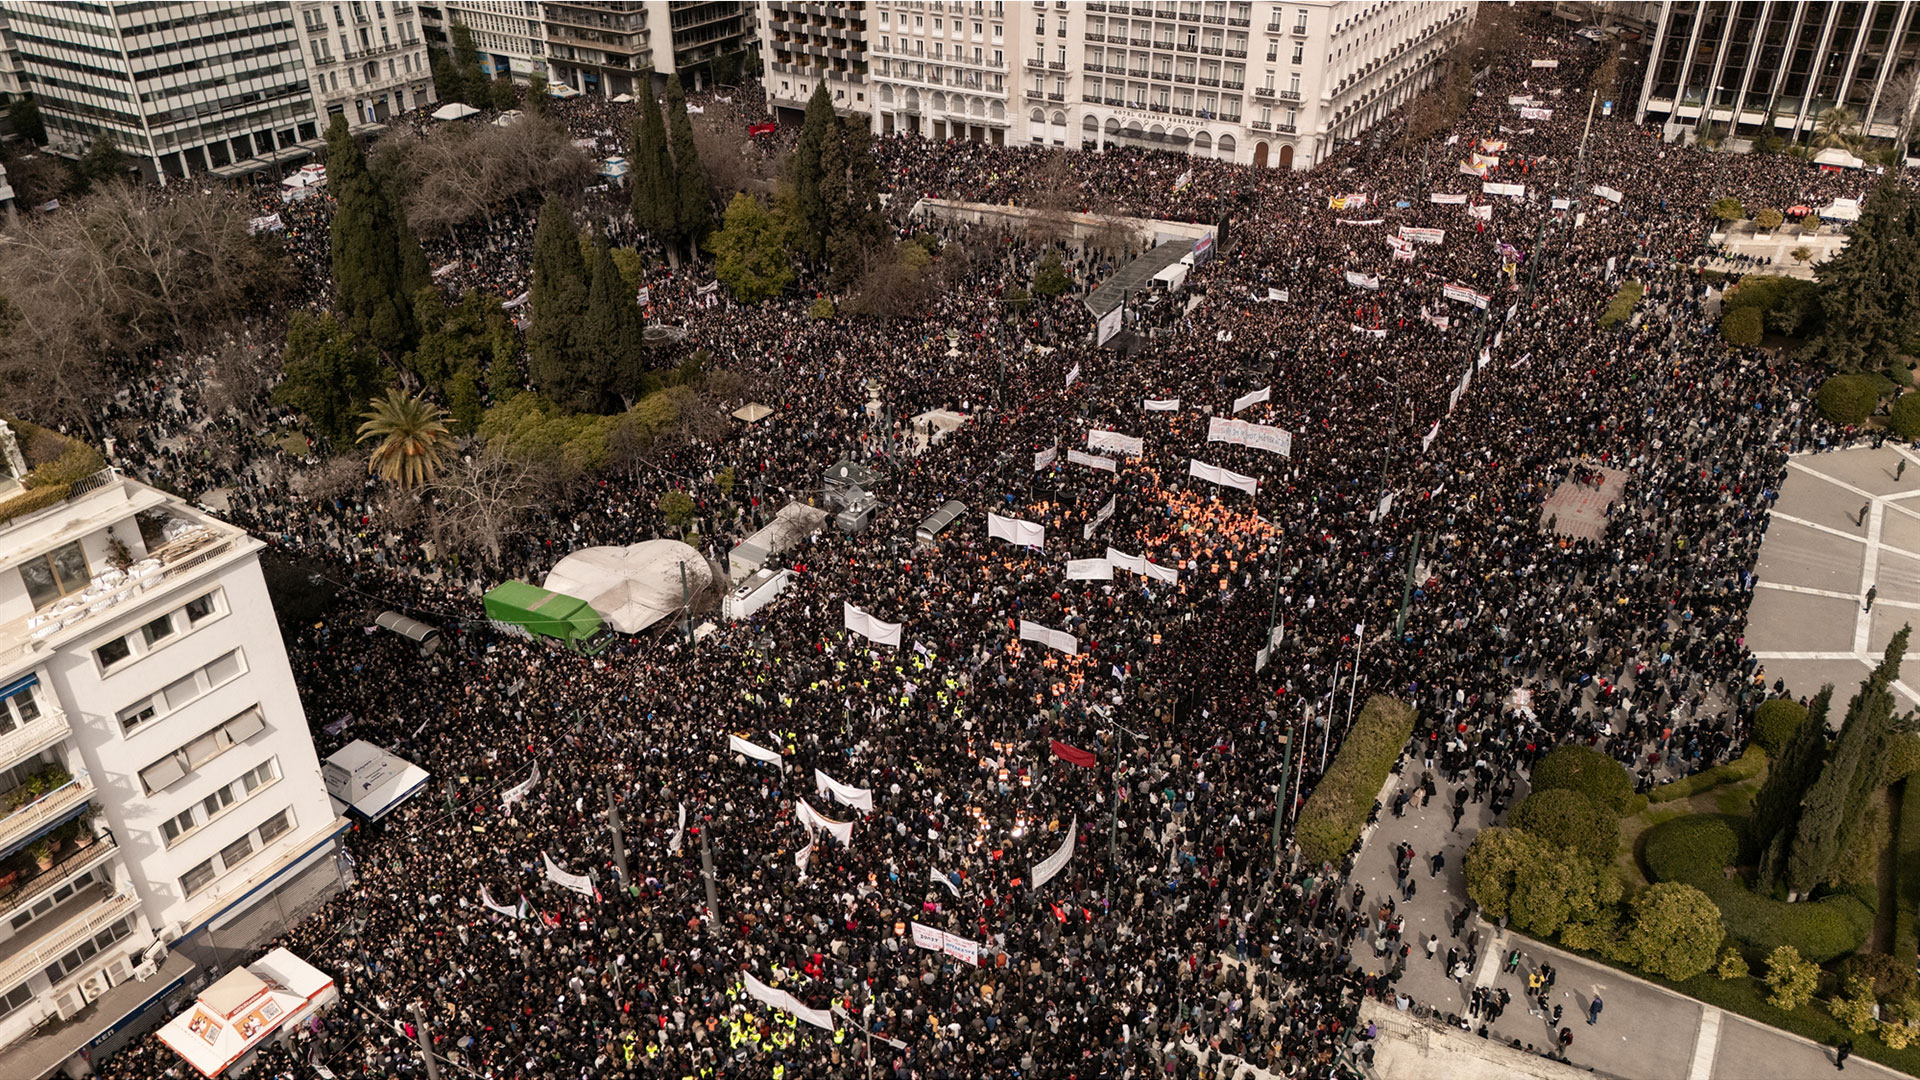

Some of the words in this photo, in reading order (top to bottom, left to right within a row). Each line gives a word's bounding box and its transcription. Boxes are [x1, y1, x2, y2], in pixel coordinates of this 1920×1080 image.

[1138, 112, 1165, 121] GRANDE
[1168, 117, 1204, 126] BRETAGNE
[95, 1028, 115, 1045] ΚΕΠ
